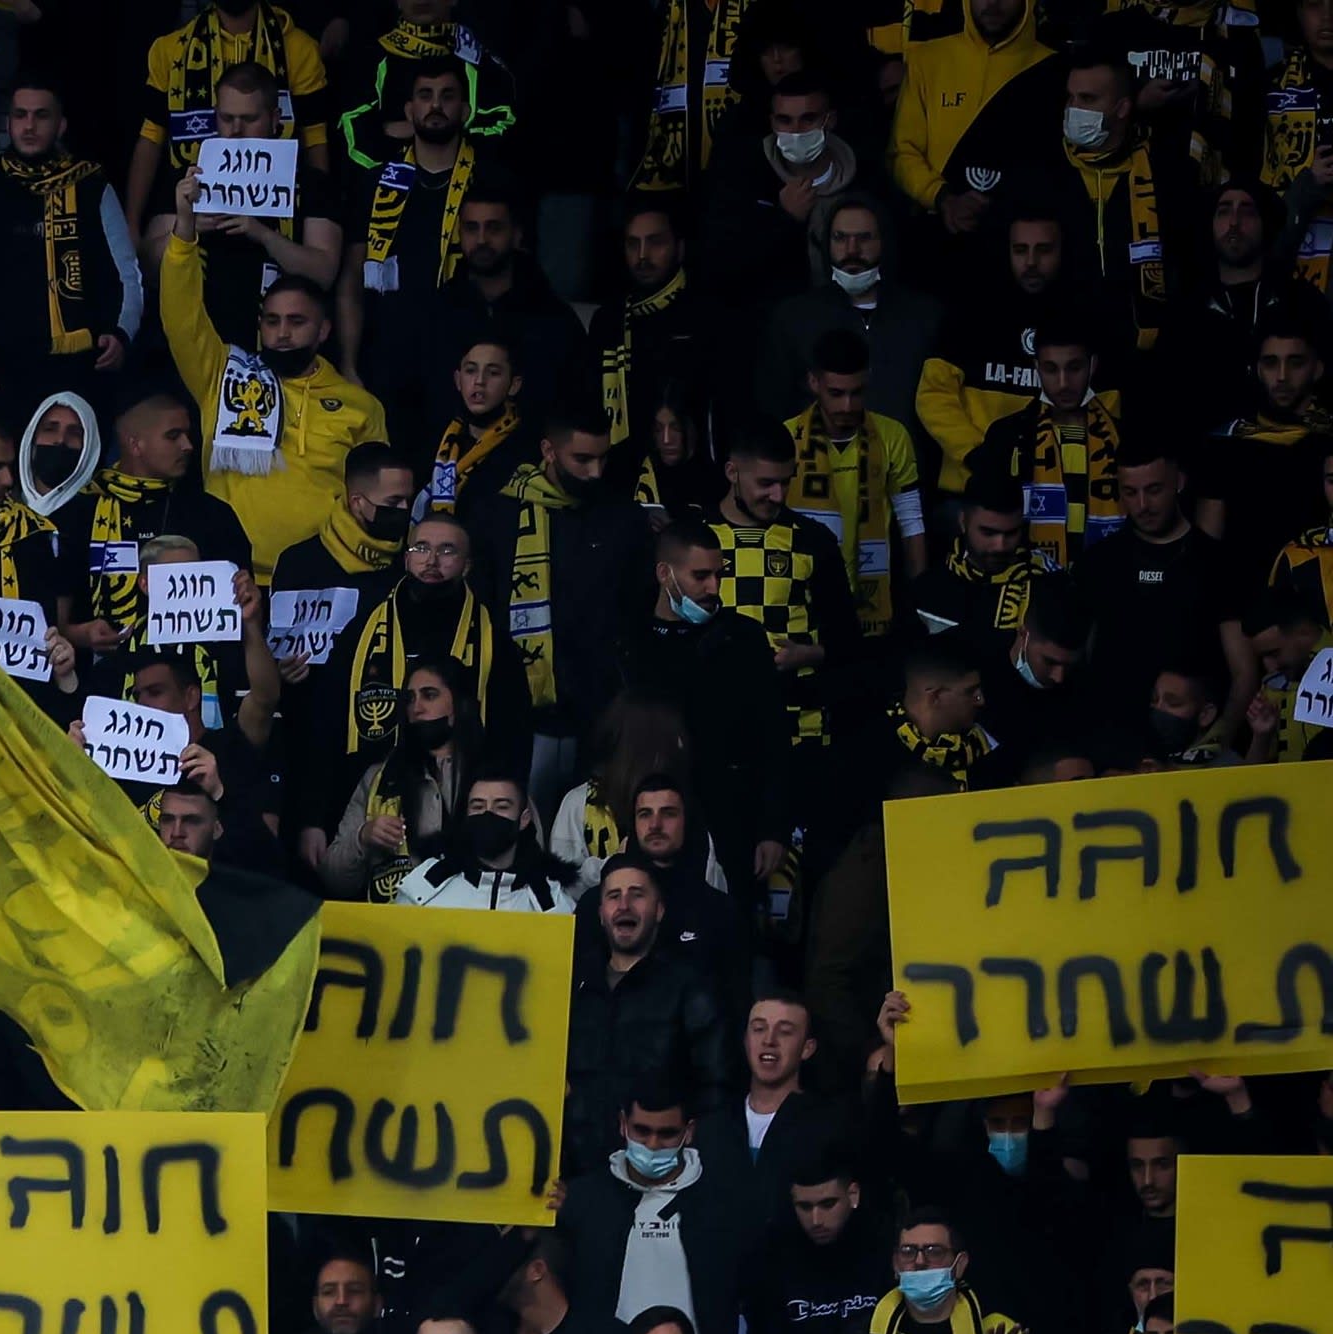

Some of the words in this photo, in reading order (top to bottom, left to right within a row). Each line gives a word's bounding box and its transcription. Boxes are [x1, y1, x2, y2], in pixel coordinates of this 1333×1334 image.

[217, 149, 272, 175] חוגג
[198, 181, 291, 209] תשחרר
[168, 574, 216, 599] חוגג
[152, 607, 238, 634] תשחרר
[104, 710, 165, 741] חוגג
[973, 797, 1305, 908] חוגג
[306, 938, 529, 1045] חוג
[280, 1089, 551, 1199] תשח
